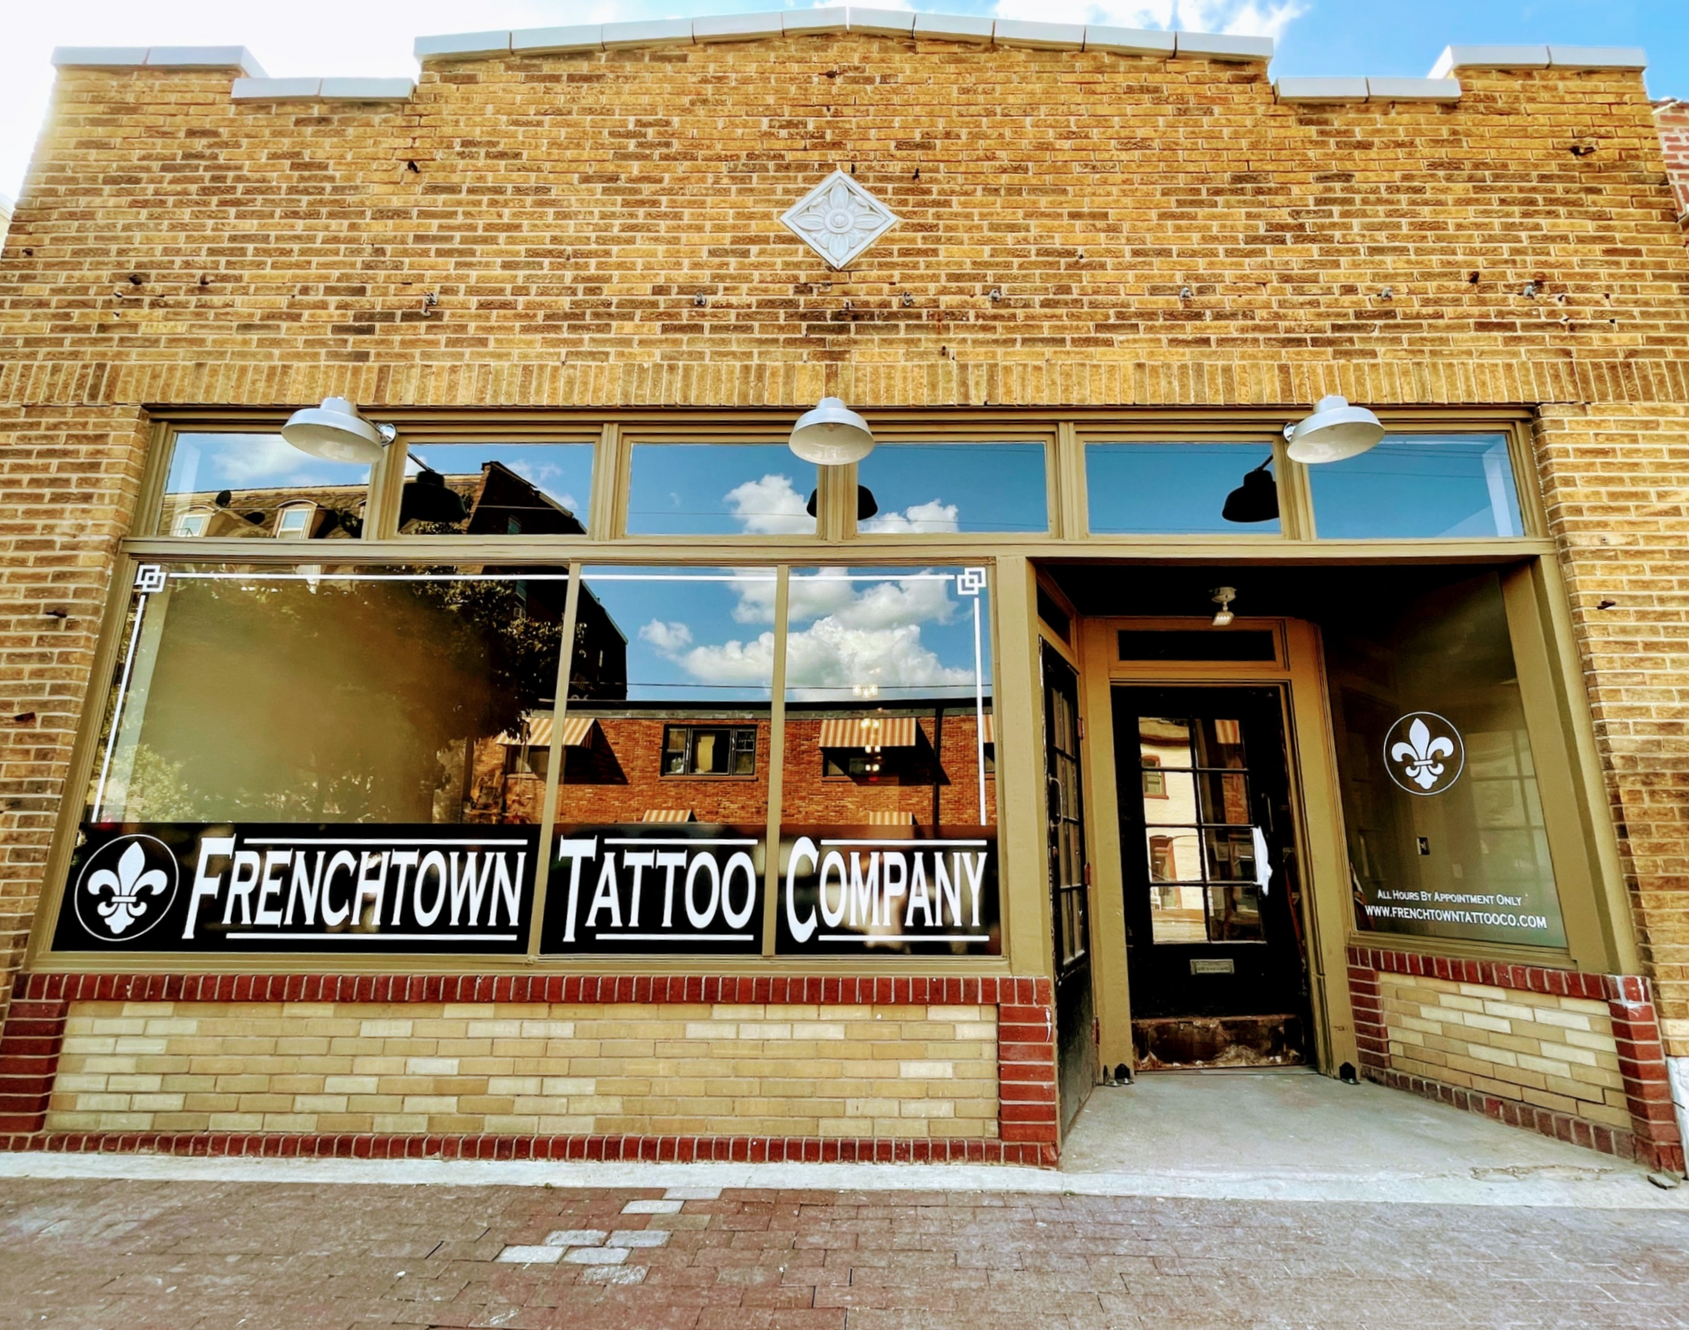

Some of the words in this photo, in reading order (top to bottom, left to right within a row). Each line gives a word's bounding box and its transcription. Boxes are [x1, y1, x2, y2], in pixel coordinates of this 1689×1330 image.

[182, 833, 527, 940] FRENCHTOWN
[559, 835, 756, 942] TATTOO
[786, 836, 988, 943] COMPANY
[1377, 889, 1392, 900] ALL
[1392, 889, 1420, 901] HOURS
[1420, 890, 1432, 902] BY
[1433, 891, 1495, 905] APPOINTMENT
[1496, 894, 1522, 906] ONLY
[1364, 905, 1547, 929] WWW.FRENCHTOWNTATTOOCO.COM
